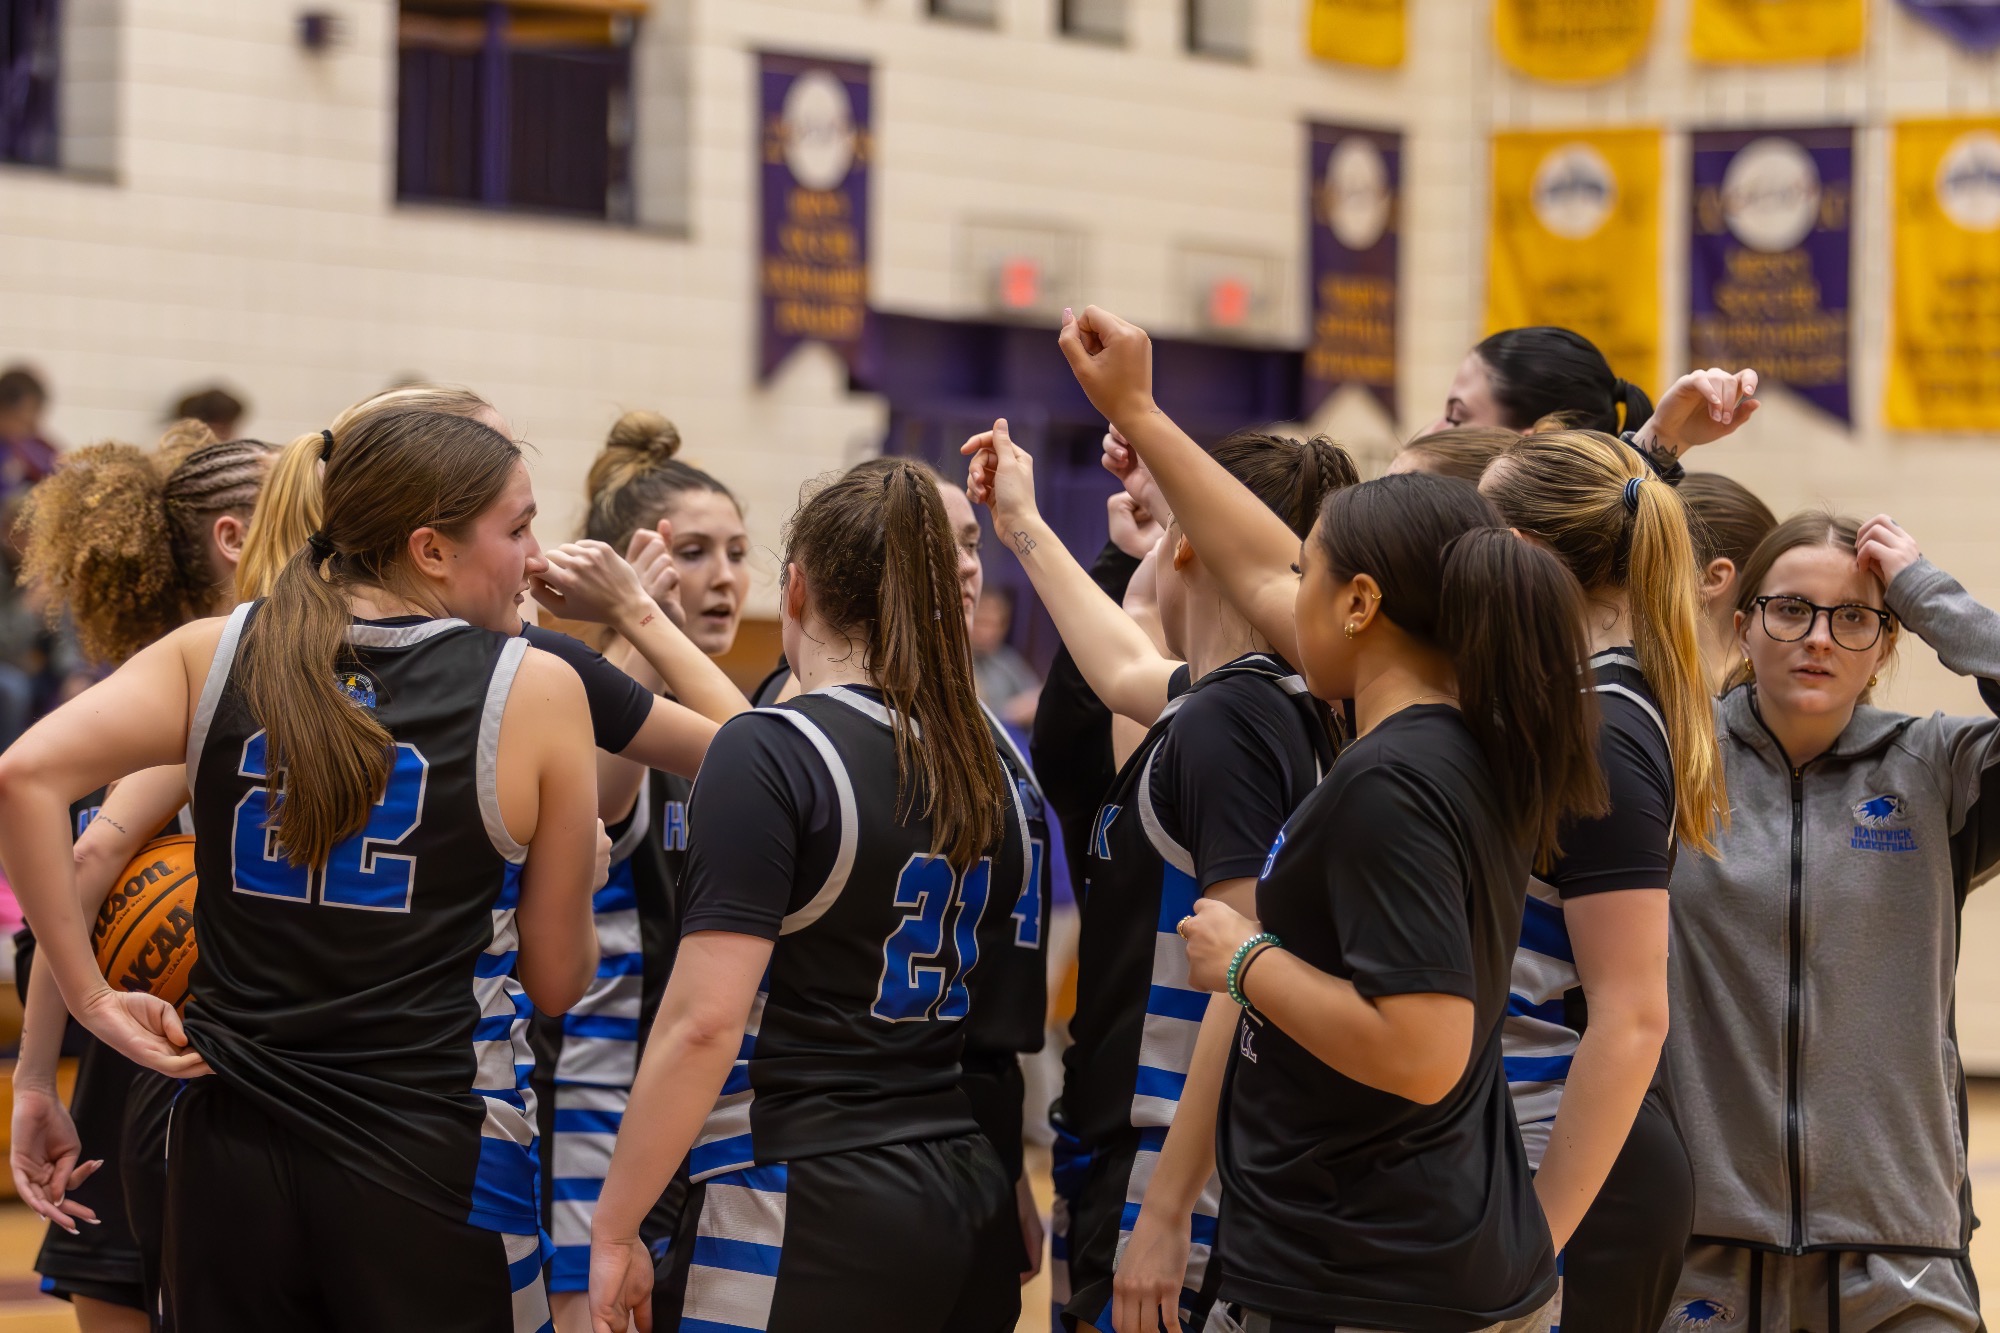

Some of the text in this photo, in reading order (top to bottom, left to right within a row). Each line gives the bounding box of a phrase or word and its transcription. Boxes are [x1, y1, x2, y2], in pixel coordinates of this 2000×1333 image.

[231, 726, 429, 913] 22
[119, 905, 195, 993] NCAA
[870, 852, 993, 1023] 21
